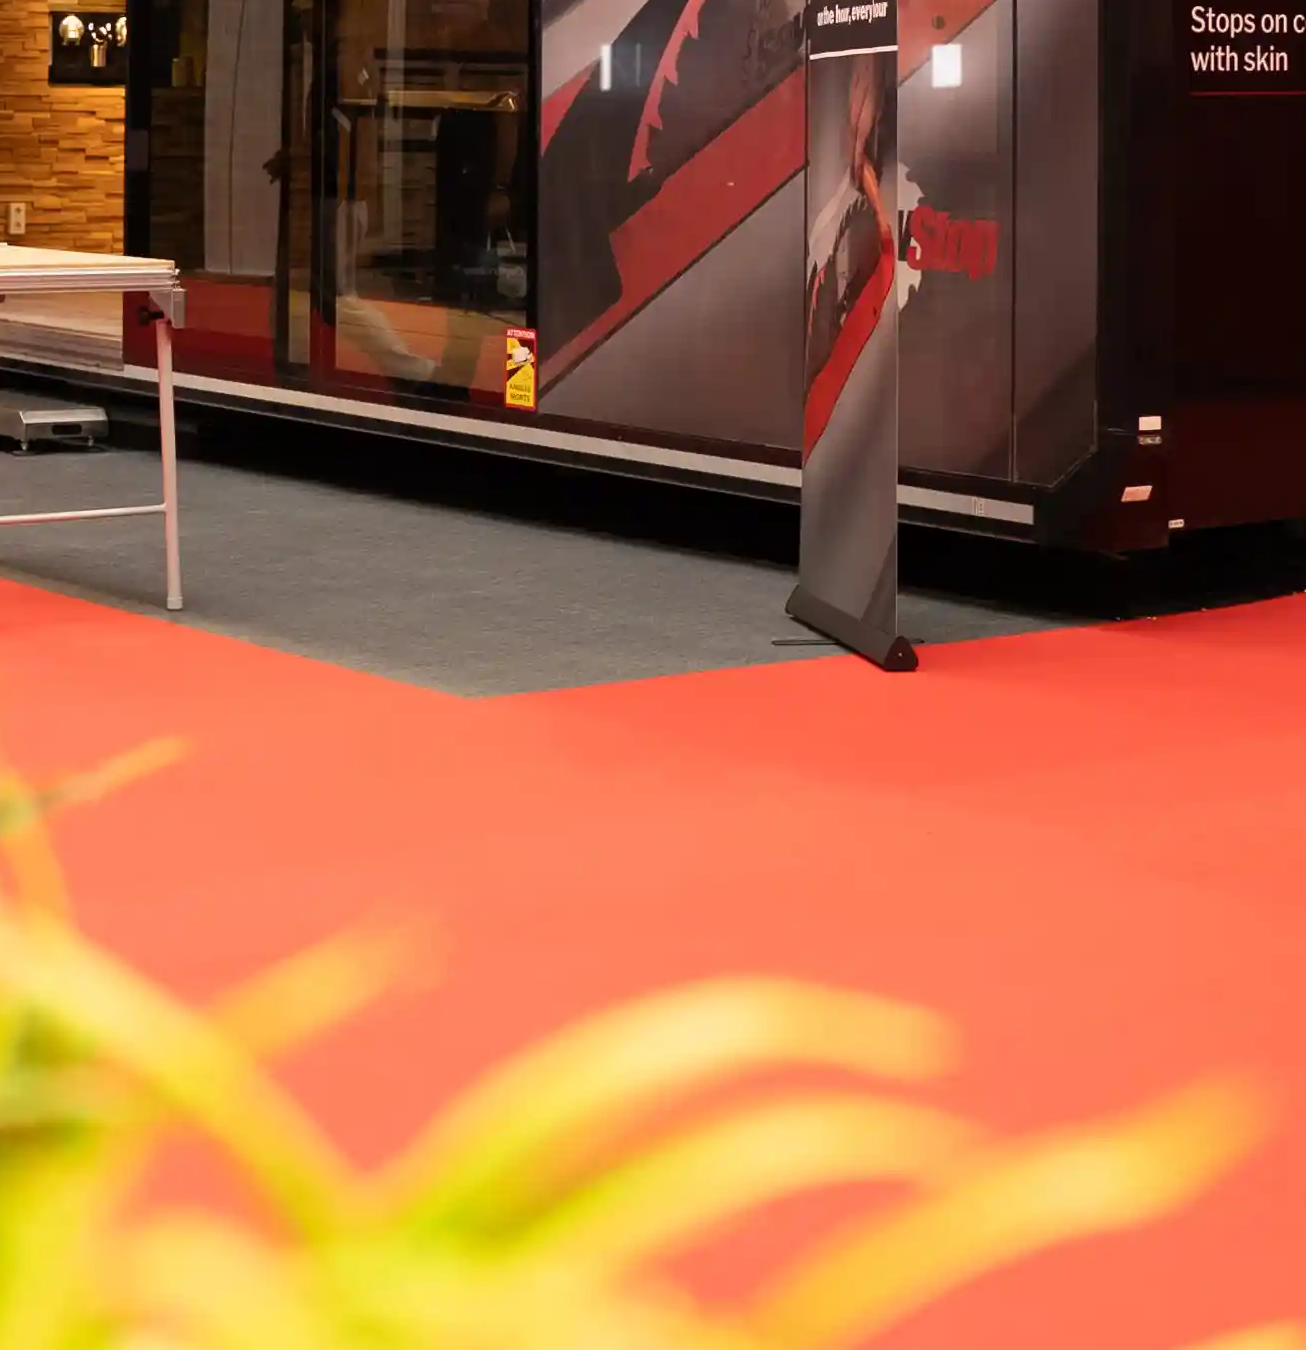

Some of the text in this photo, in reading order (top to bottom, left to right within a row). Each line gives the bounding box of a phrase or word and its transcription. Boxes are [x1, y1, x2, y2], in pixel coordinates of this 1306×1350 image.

[1190, 6, 1256, 38] Stops
[1260, 13, 1288, 34] on
[1190, 45, 1289, 72] with skin
[898, 204, 1001, 282] Stop
